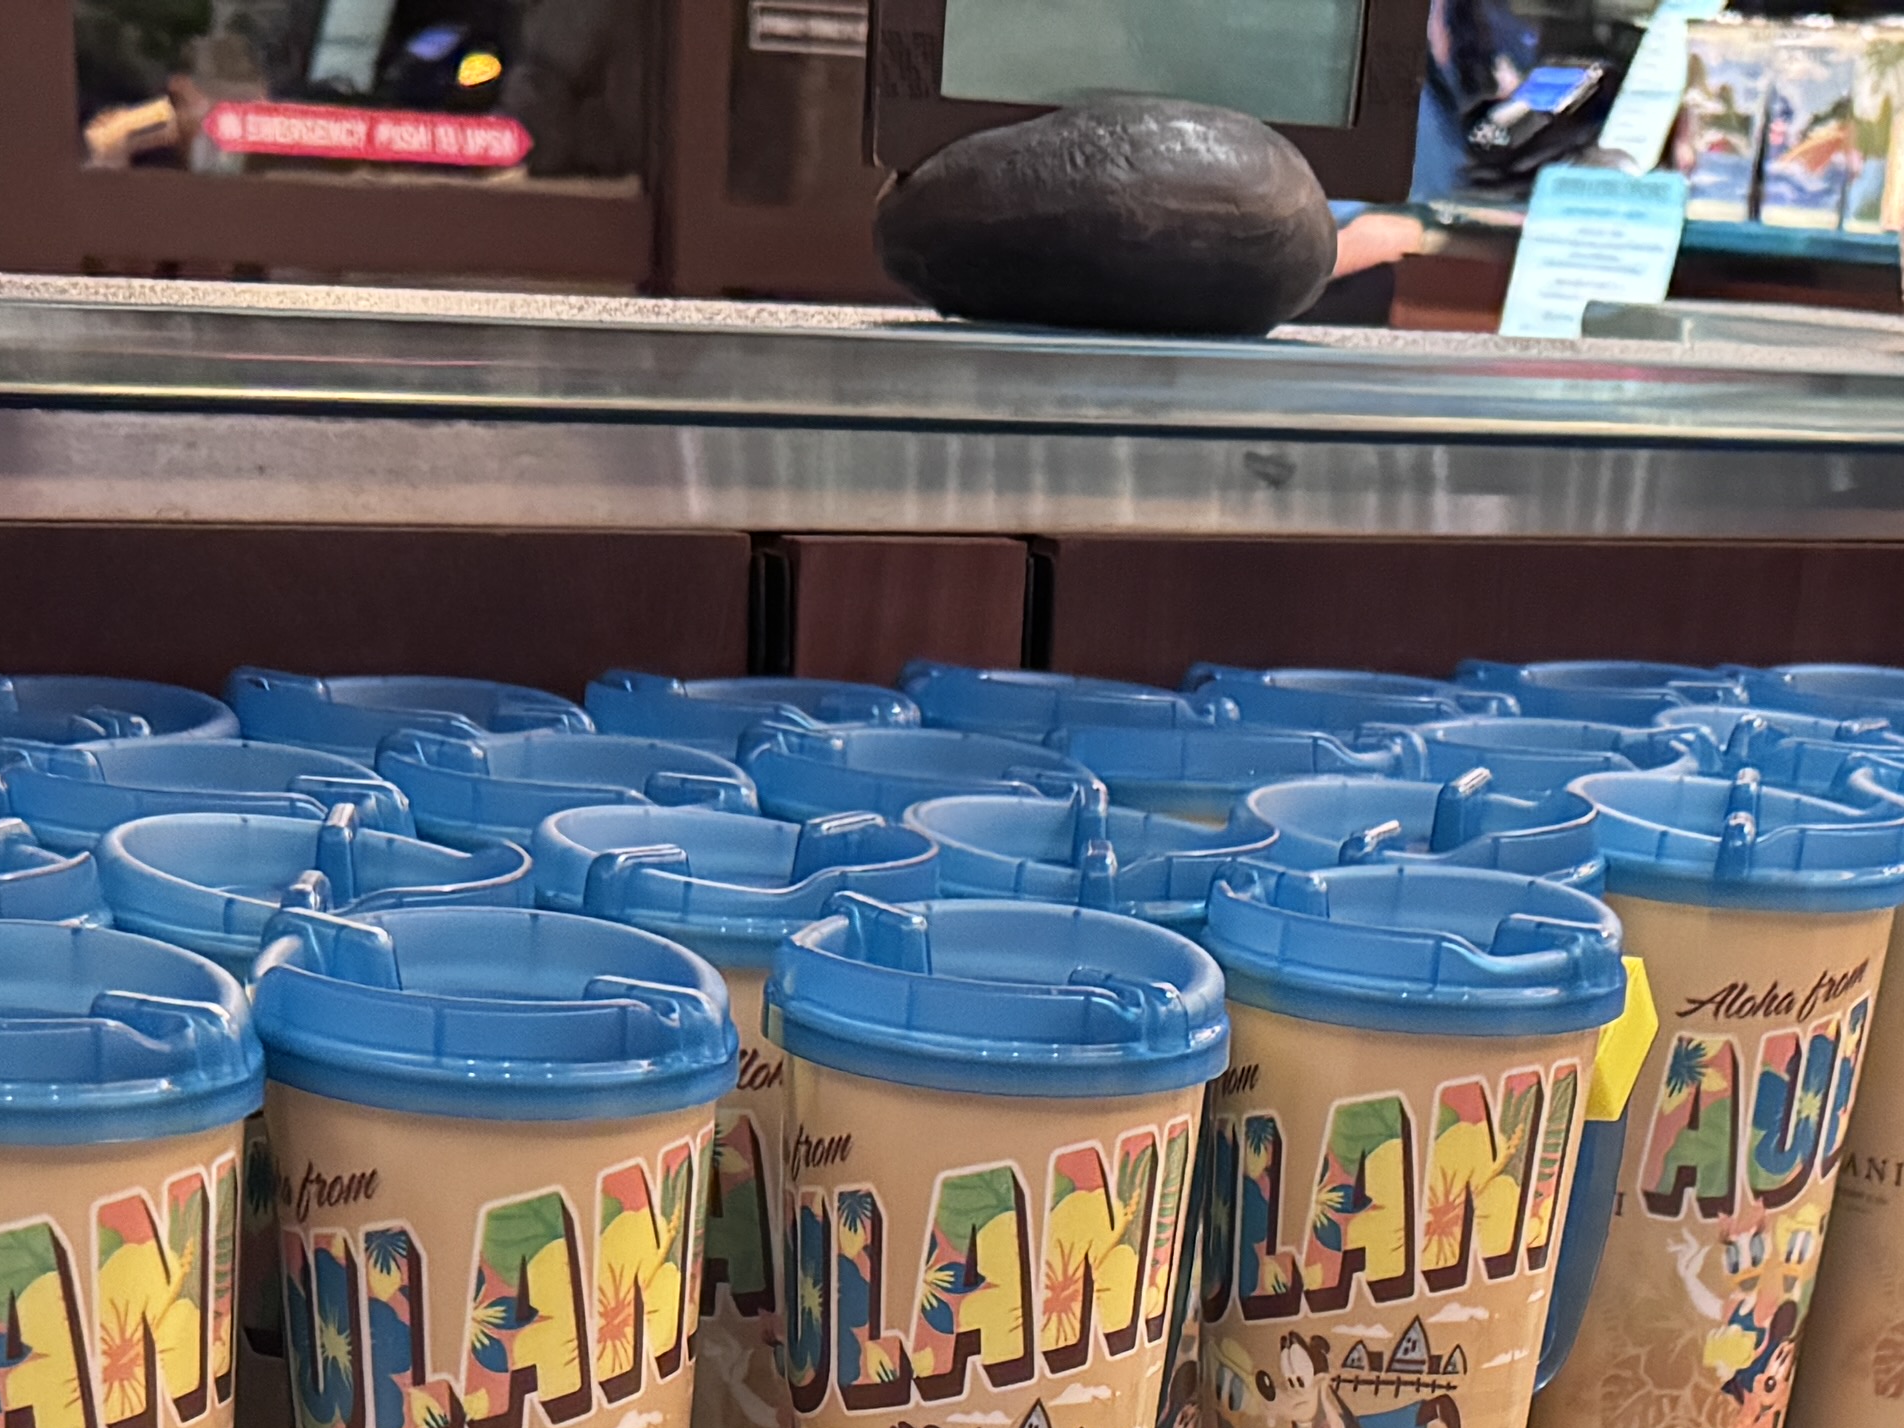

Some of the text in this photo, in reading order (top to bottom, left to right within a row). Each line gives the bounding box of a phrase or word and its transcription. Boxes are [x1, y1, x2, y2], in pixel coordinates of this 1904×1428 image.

[1676, 958, 1869, 1023] Aloha from
[791, 1122, 853, 1181] from
[299, 1162, 380, 1222] from
